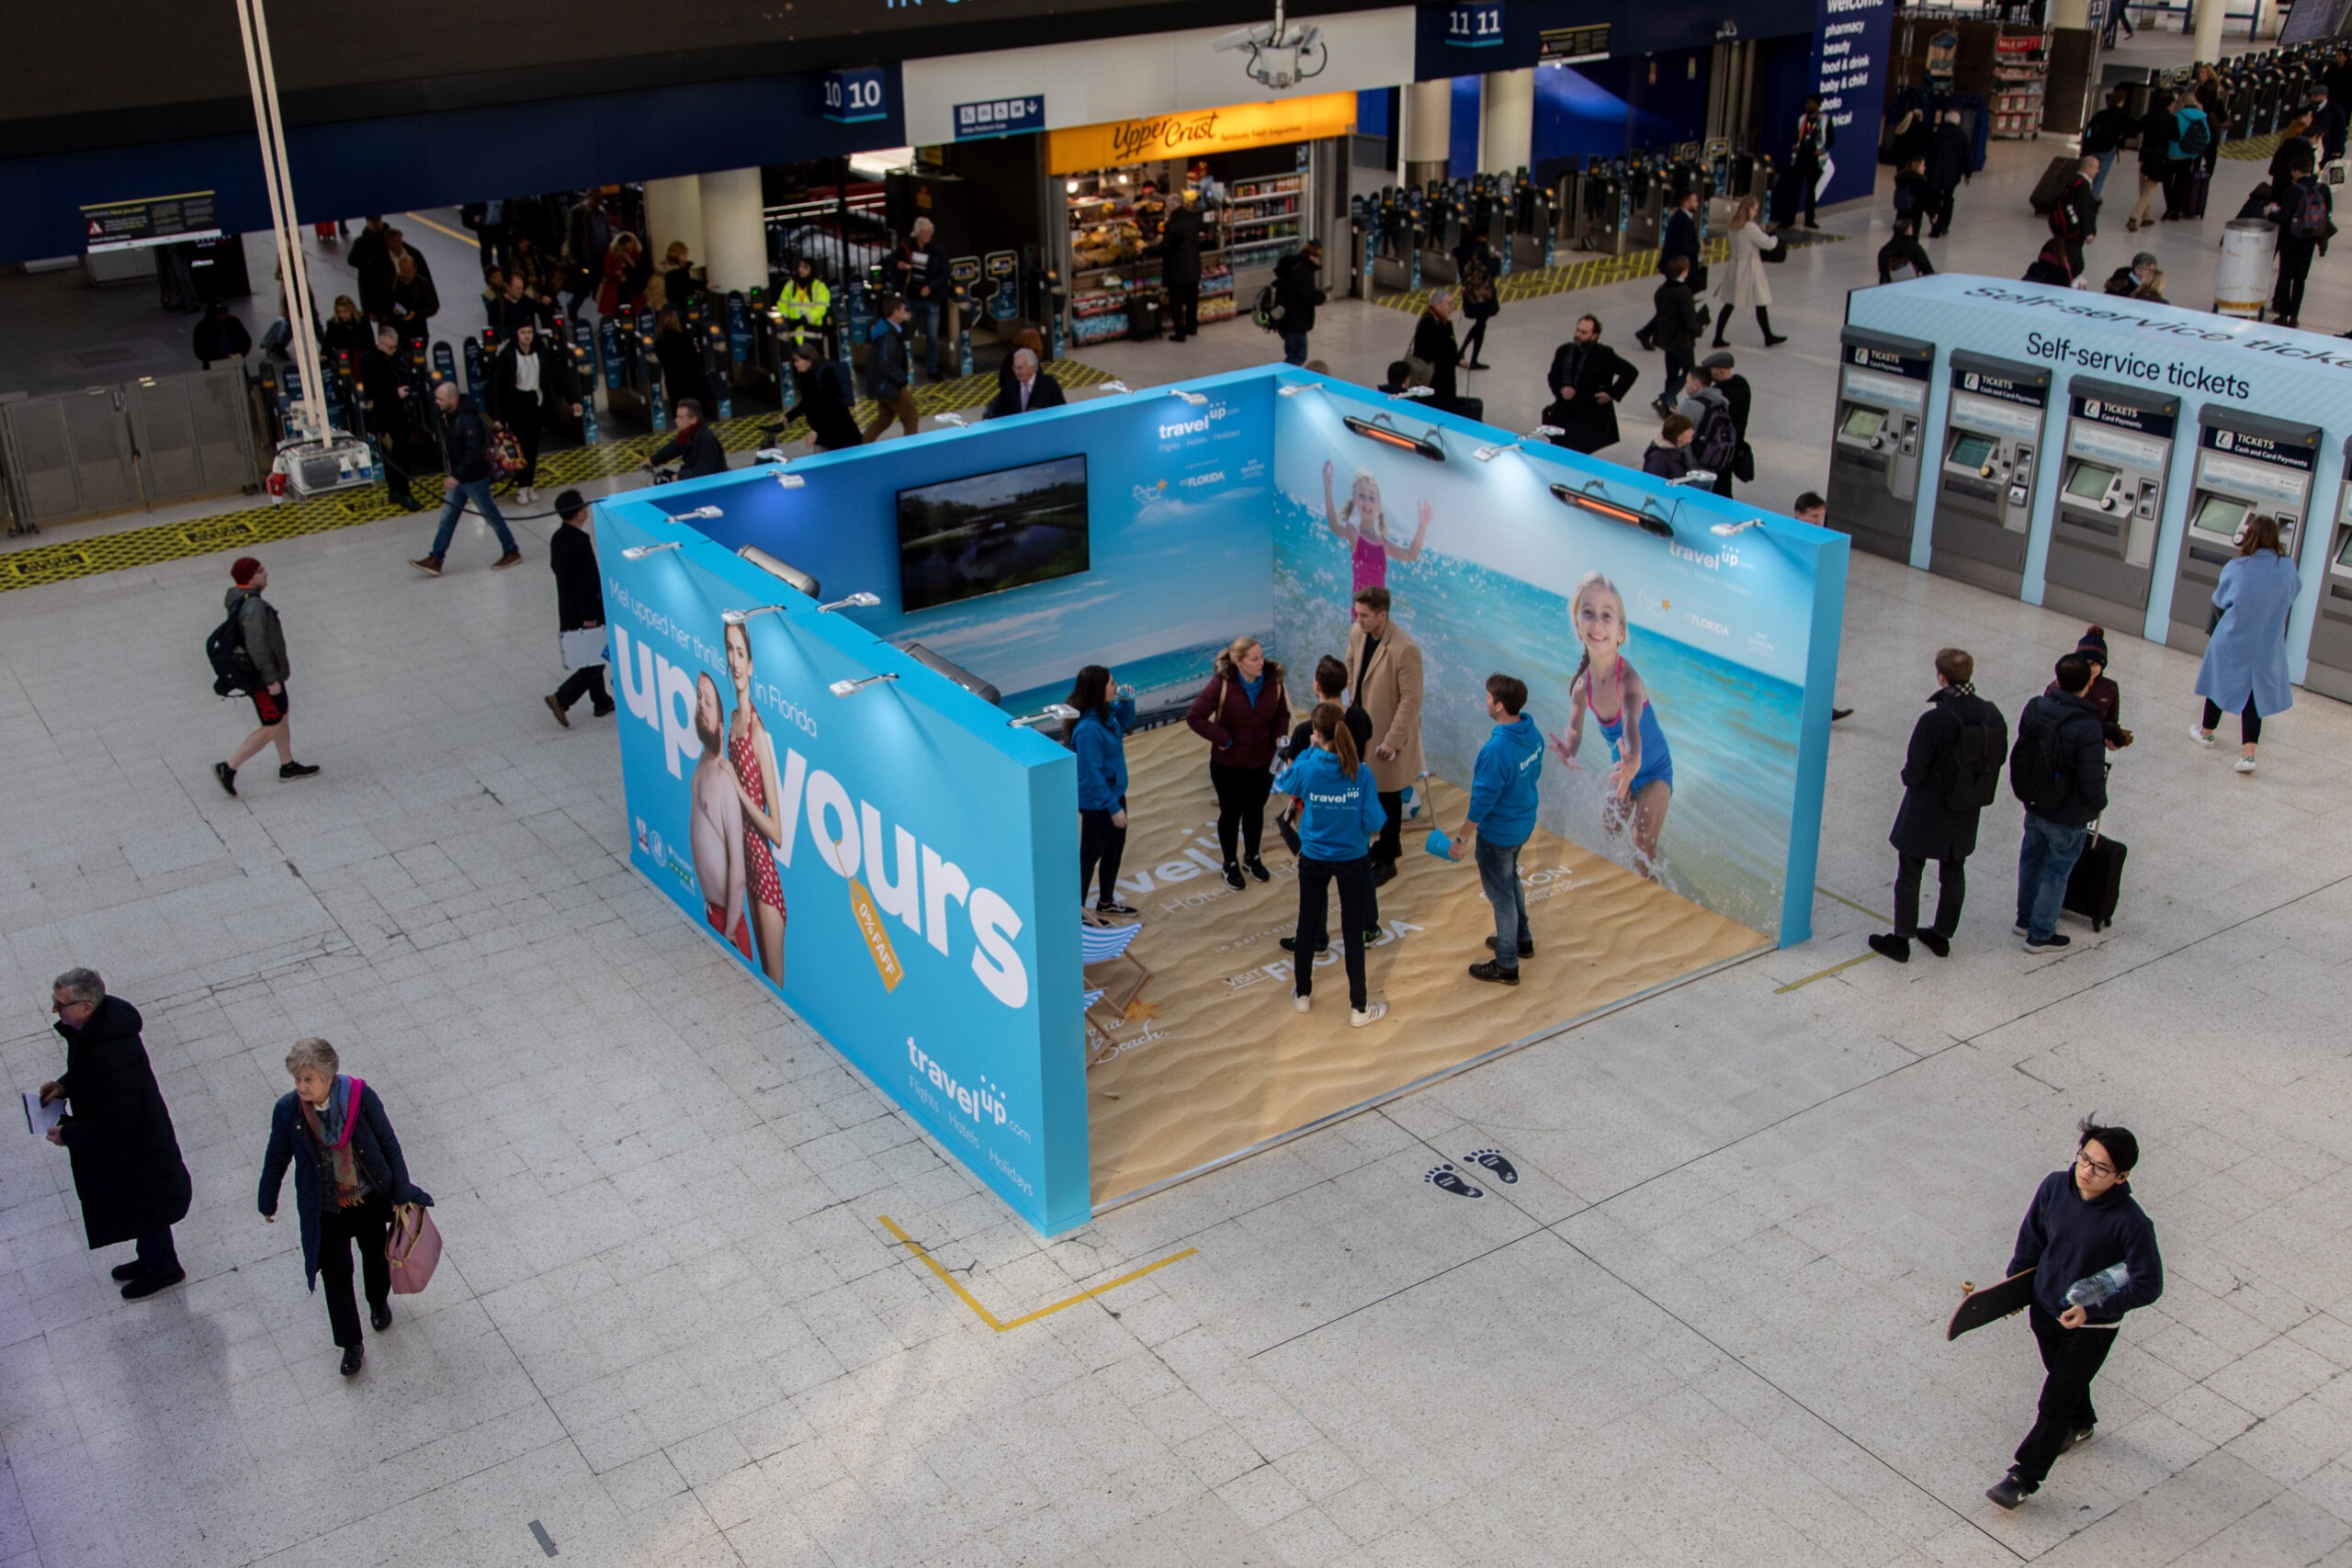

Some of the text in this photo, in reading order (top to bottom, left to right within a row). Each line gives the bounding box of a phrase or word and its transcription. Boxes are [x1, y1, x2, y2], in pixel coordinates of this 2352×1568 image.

[2091, 1, 2103, 15] 13
[1449, 10, 1470, 35] 11
[1477, 9, 1501, 35] 11
[1824, 20, 1865, 39] pharmacy
[1823, 39, 1851, 56] beauty
[1821, 58, 1841, 74] food
[1849, 53, 1870, 70] drink
[823, 80, 842, 108] 10
[848, 79, 881, 108] 10
[1819, 78, 1840, 94] baby
[1848, 72, 1869, 88] child
[1114, 111, 1219, 160] Upper Crust
[1963, 287, 2235, 342] Self-service
[1871, 349, 1900, 365] TICKETS
[2026, 332, 2250, 399] Self-service tickets
[1982, 375, 2013, 389] TICKETS
[2103, 402, 2138, 419] TICKETS
[2114, 417, 2143, 430] Payments
[2236, 433, 2276, 450] TICKETS
[2234, 445, 2308, 468] Cash and Card Payments
[1188, 471, 1226, 487] FLORIDA
[609, 577, 817, 739] Mel upped her thrills in Florida
[615, 624, 704, 780] up
[766, 732, 1028, 1009] yours
[1160, 882, 1238, 915] Hotel
[859, 903, 896, 975] 0% FAFF
[1223, 967, 1261, 987] VISIT
[909, 1075, 1034, 1197] Flights Hotels Holidays
